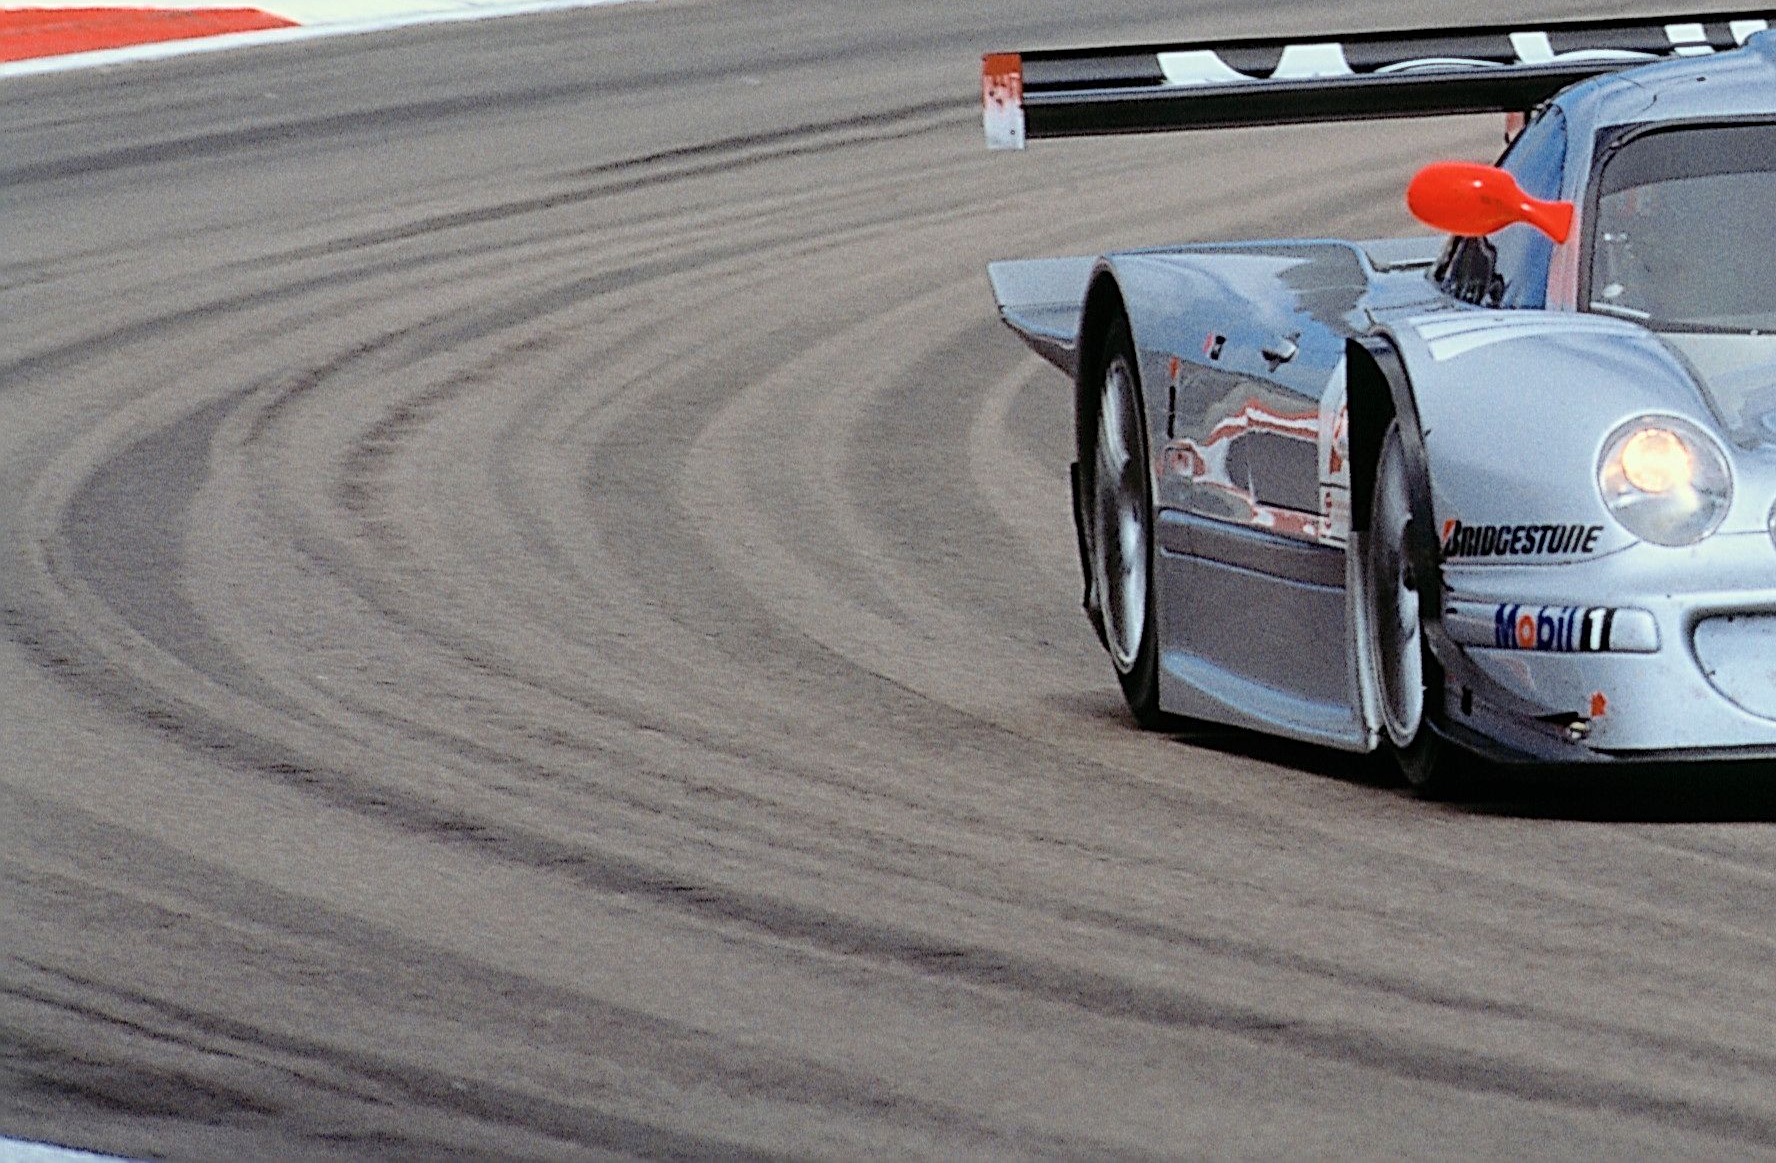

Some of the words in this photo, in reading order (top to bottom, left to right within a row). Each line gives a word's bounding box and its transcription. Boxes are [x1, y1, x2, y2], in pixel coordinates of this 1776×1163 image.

[1441, 518, 1604, 558] BRIDGESTONE
[1496, 604, 1576, 651] Mobil
[1587, 607, 1605, 652] 1
